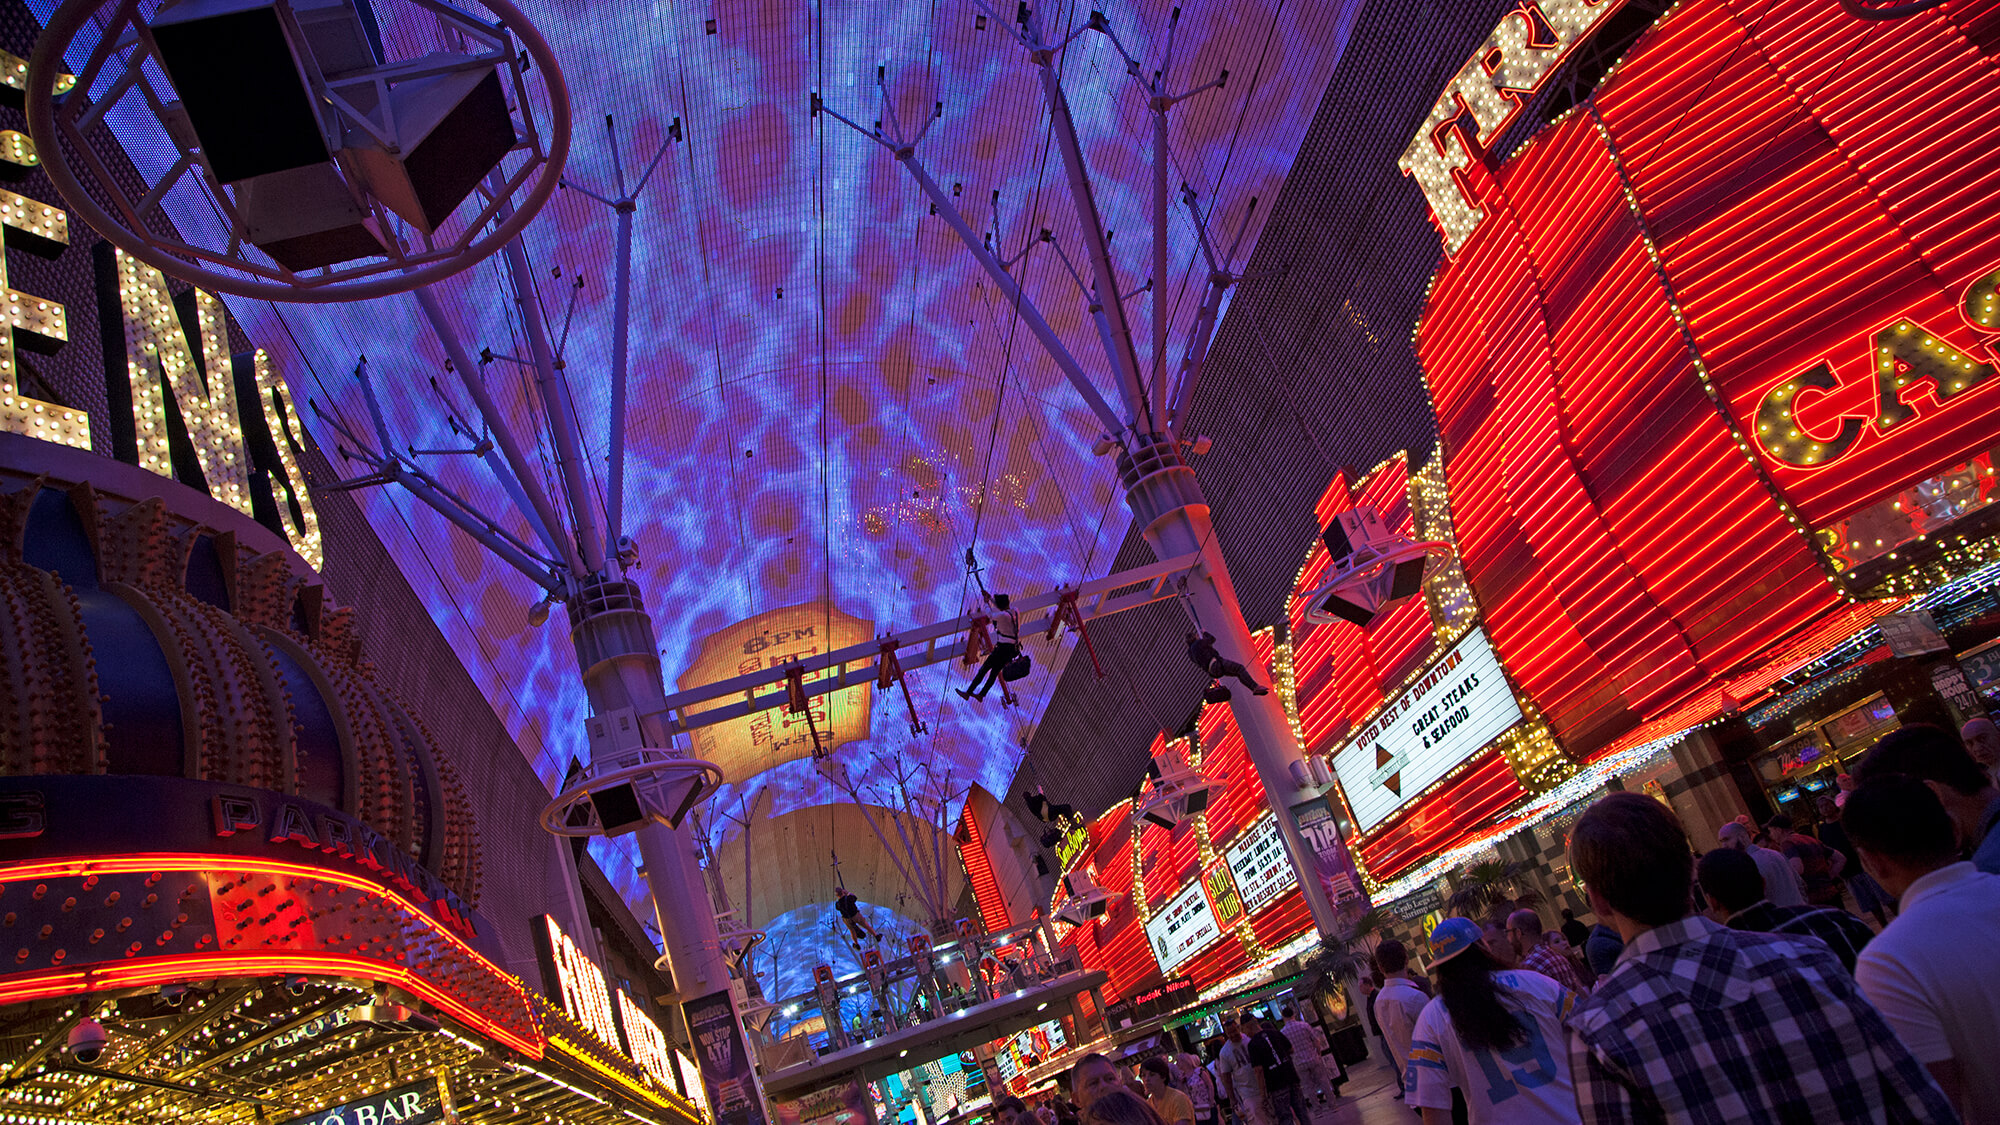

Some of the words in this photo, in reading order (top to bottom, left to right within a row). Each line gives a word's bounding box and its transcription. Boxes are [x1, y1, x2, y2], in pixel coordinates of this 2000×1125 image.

[1932, 672, 1966, 692] HAPPY
[1940, 682, 1970, 699] HOUR
[1356, 727, 1380, 751] VOTED
[1379, 706, 1399, 731] BEST
[1400, 695, 1411, 712] OF
[1412, 649, 1463, 701] DOWNTOWN
[1412, 705, 1440, 736] GREAT
[1441, 673, 1480, 711] STEAKS
[1954, 690, 1979, 710] 24/7
[1422, 736, 1431, 749] &
[1431, 705, 1470, 744] SEAFOOD
[1238, 830, 1261, 854] PARADISE
[1233, 850, 1254, 874] WEEKDAY
[1253, 838, 1271, 860] LUNCH
[1207, 867, 1229, 898] SLOT
[1244, 866, 1257, 881] FROM
[1257, 881, 1277, 903] DESSERT
[1216, 892, 1240, 922] CLUB
[1394, 899, 1413, 914] Crab
[1413, 897, 1430, 909] Legs
[1401, 905, 1429, 921] Shrimp
[1135, 989, 1162, 1005] Kodak
[1166, 980, 1190, 993] Nikon
[699, 1032, 714, 1046] NON
[714, 1025, 731, 1043] STOP
[353, 1092, 425, 1125] BAR
